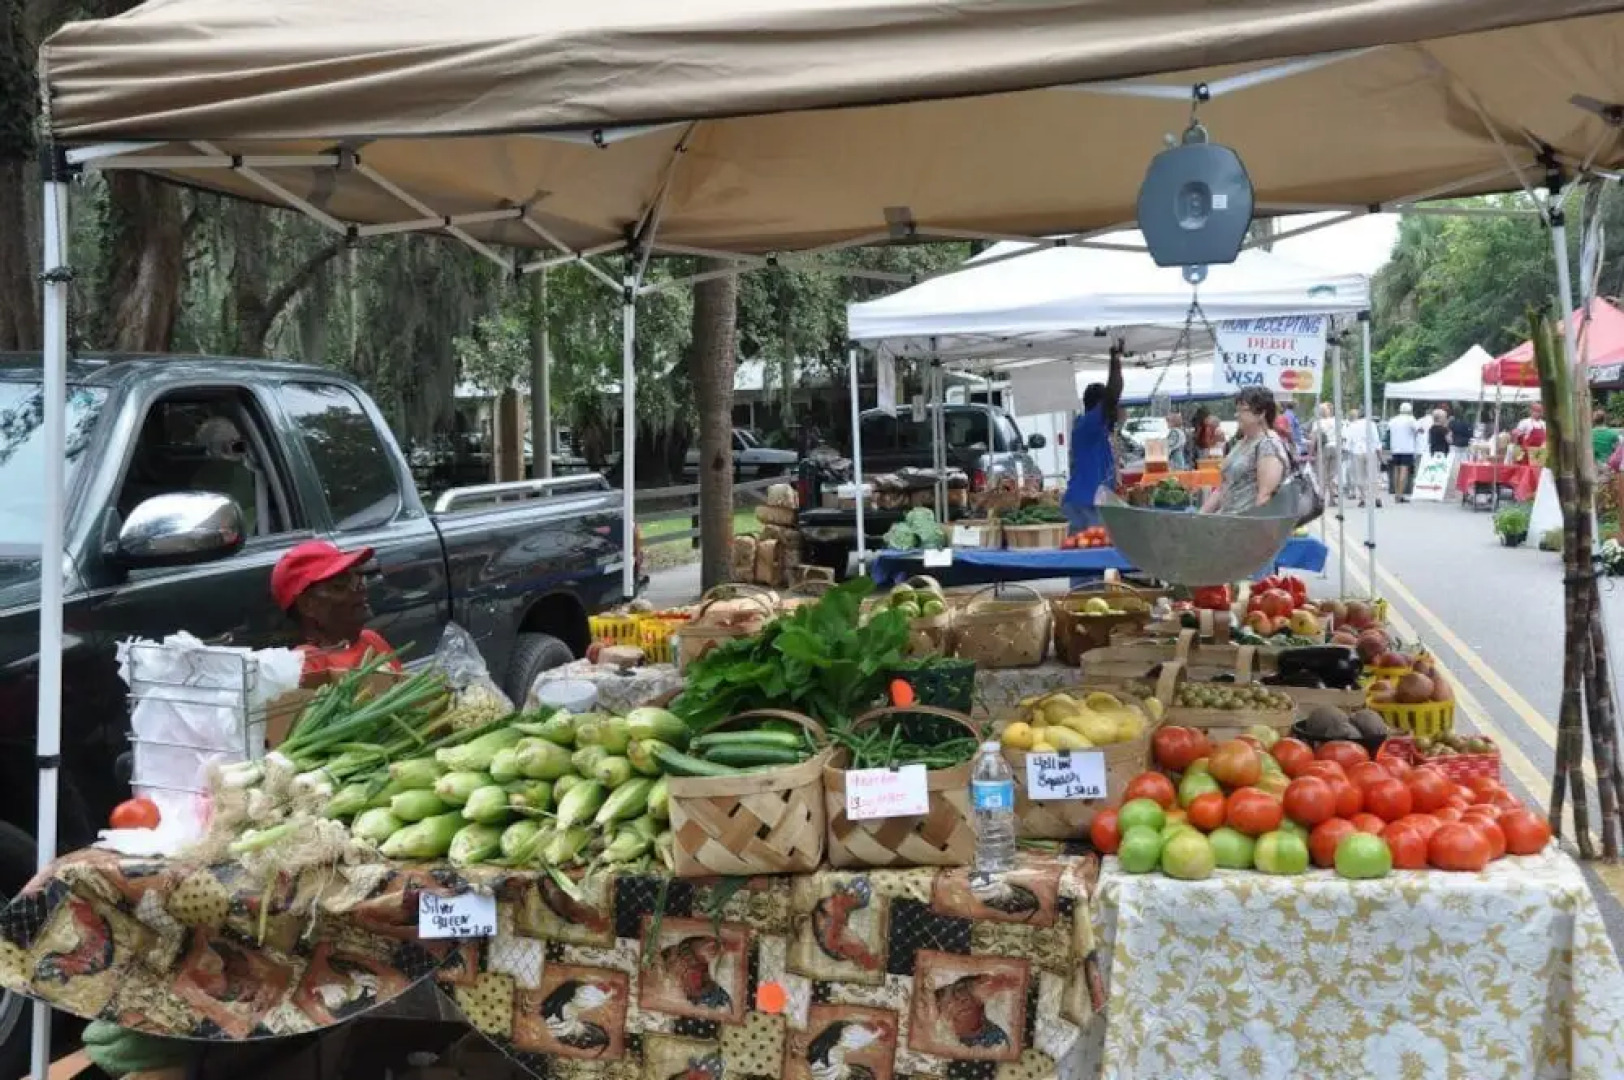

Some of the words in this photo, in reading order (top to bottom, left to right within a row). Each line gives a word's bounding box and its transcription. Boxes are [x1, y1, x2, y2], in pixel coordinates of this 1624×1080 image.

[1254, 315, 1322, 333] ACCEPTING
[1247, 336, 1298, 350] DEBIT
[1222, 351, 1260, 365] EBT
[1266, 353, 1318, 368] Cards
[422, 894, 455, 914] Silver
